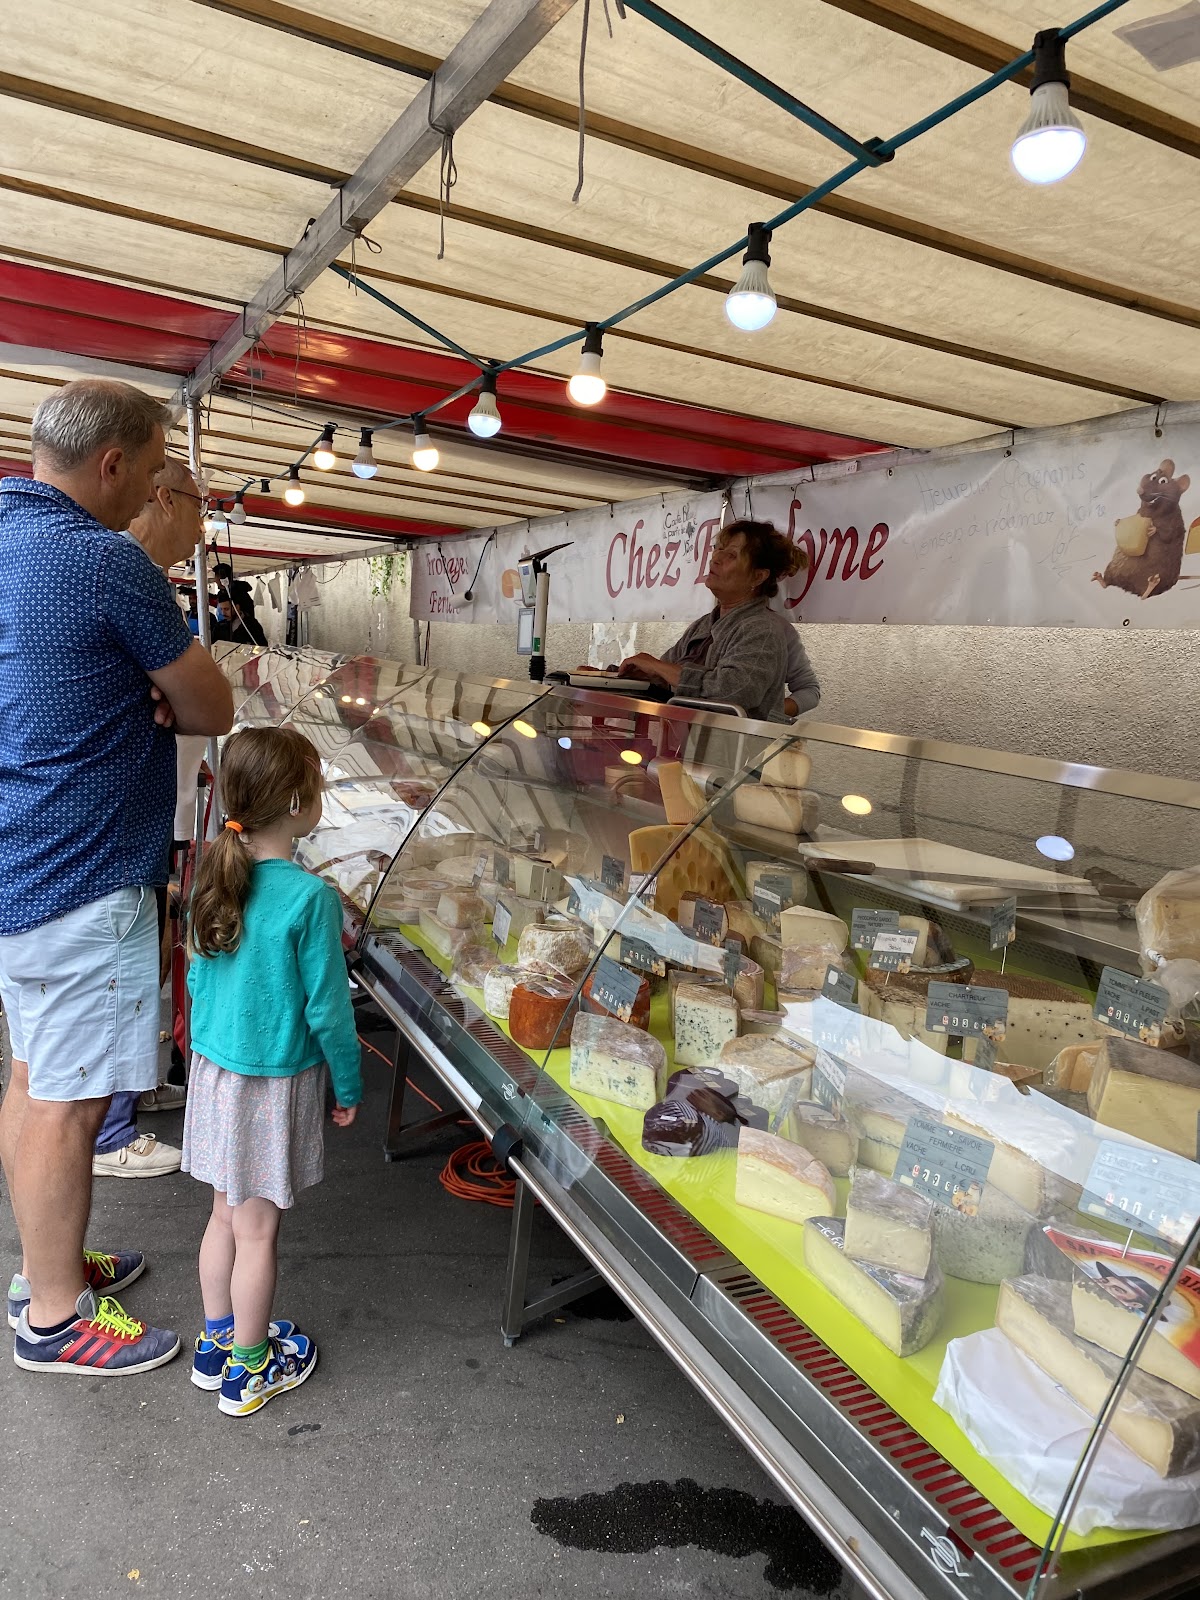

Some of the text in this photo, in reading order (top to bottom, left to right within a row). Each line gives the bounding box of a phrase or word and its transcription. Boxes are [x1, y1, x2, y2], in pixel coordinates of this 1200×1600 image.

[606, 499, 890, 610] Chez Elyne
[930, 1000, 951, 1008] VACHE
[948, 992, 987, 1002] CHARTREUX
[912, 1119, 983, 1151] TOMME SAVOIE
[906, 1141, 927, 1156] VACHE
